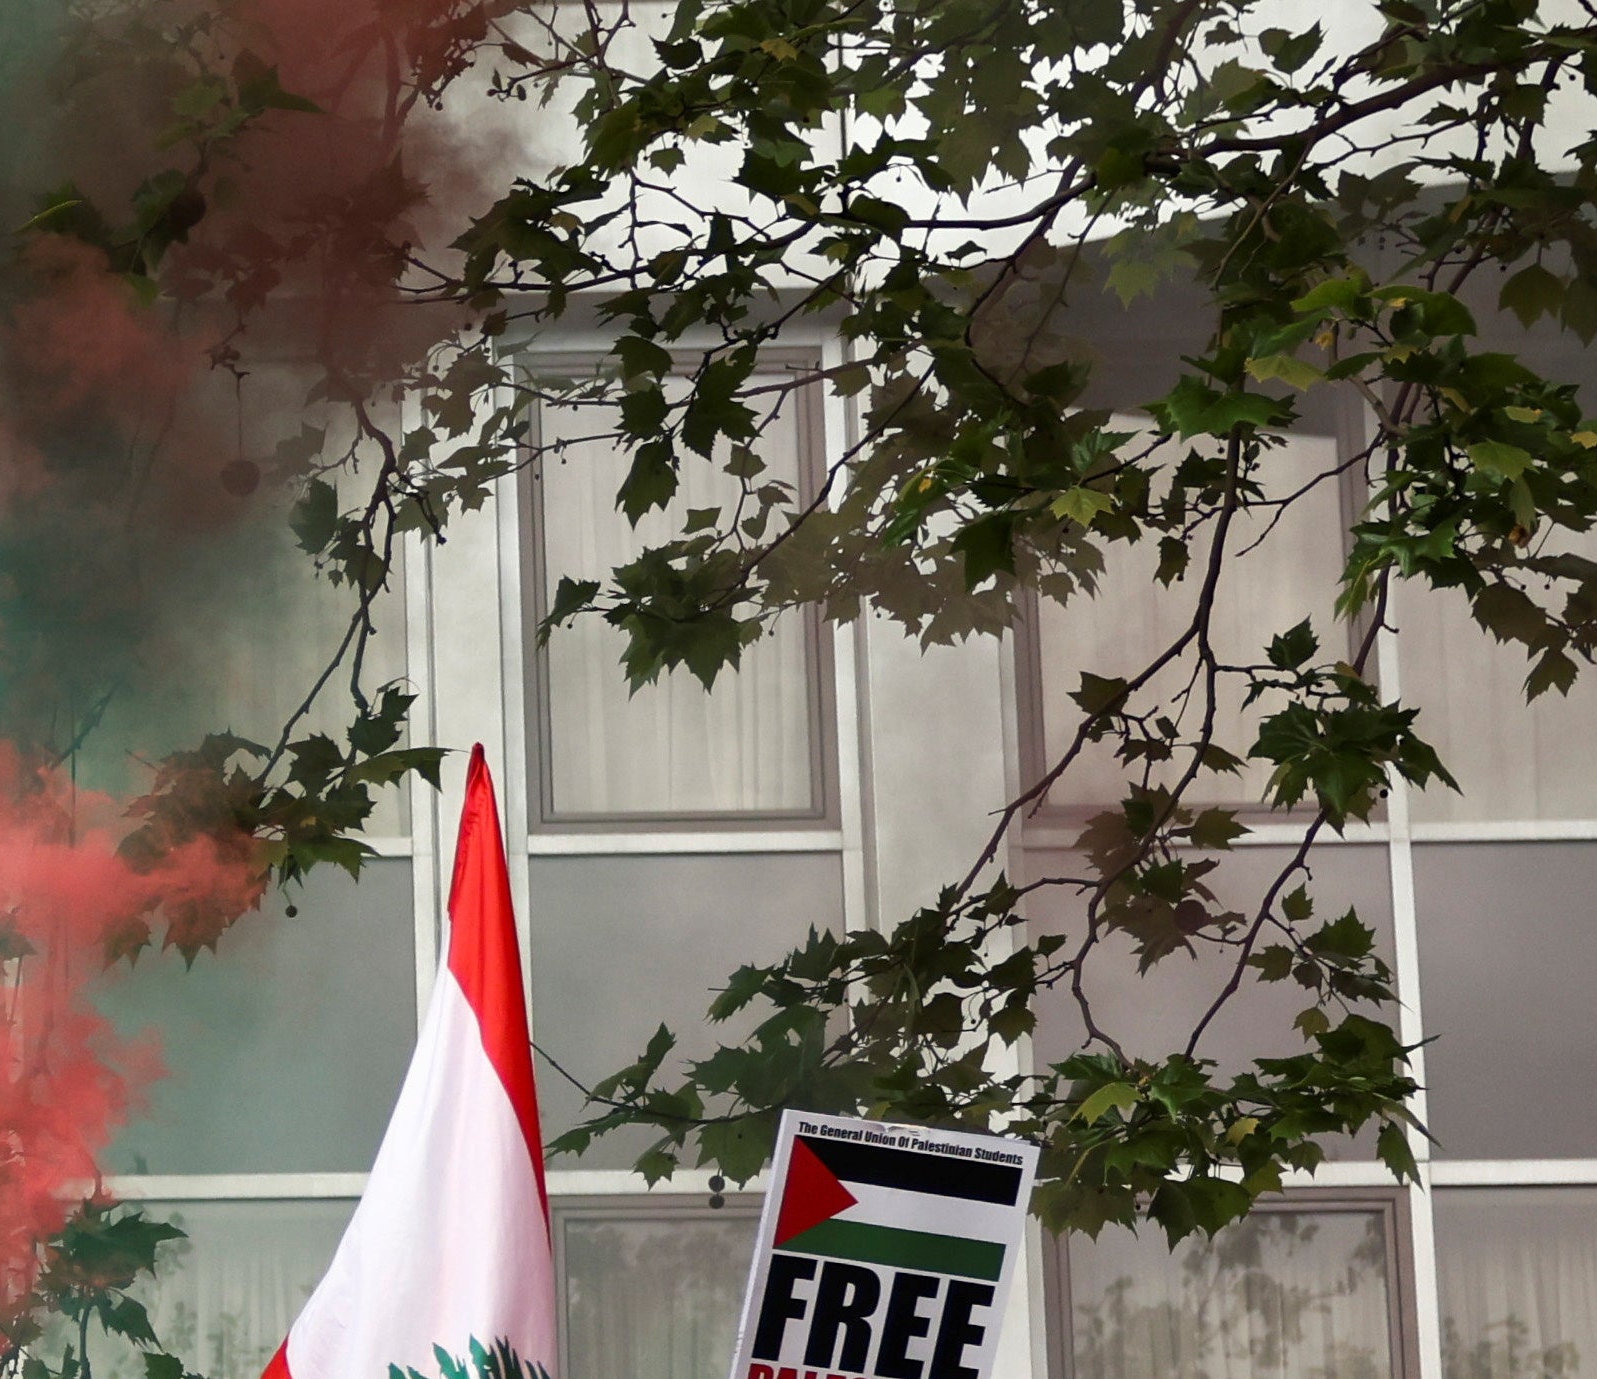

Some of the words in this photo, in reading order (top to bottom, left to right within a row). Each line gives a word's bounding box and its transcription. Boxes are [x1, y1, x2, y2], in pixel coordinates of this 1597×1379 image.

[799, 1121, 818, 1136] The
[820, 1124, 862, 1142] General
[865, 1130, 897, 1146] Union
[911, 1136, 973, 1158] Palestinian
[975, 1145, 1024, 1166] Students
